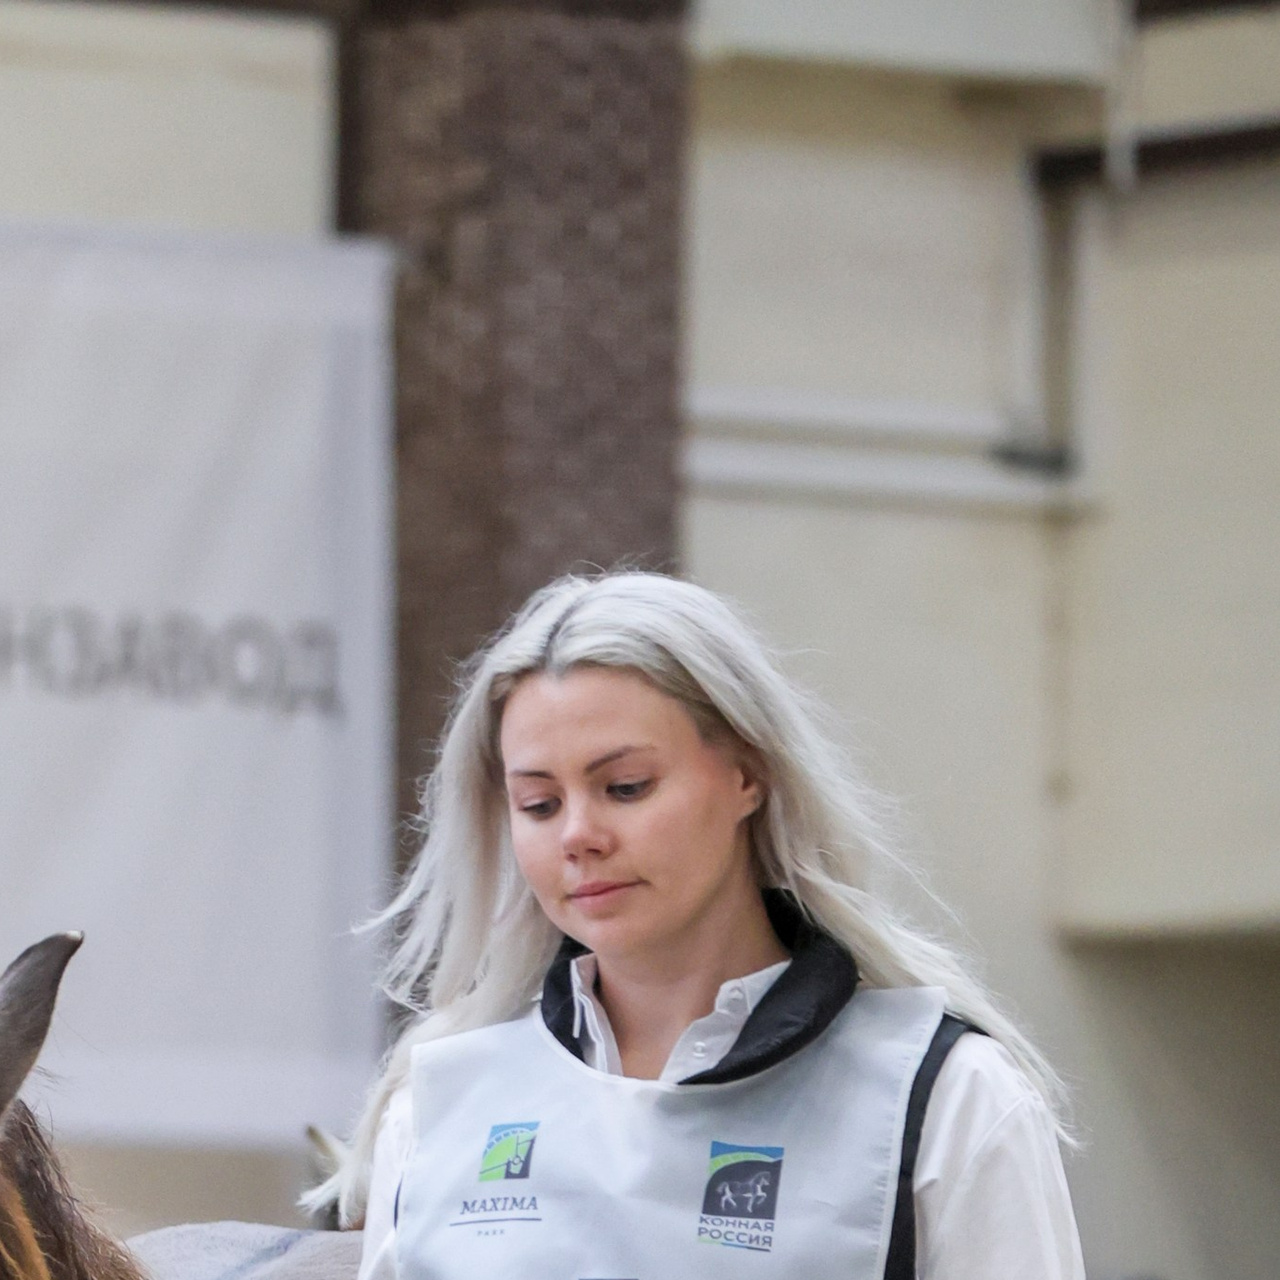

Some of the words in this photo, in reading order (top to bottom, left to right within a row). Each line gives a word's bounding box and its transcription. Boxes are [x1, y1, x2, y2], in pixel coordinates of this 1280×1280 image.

[460, 1196, 538, 1215] MAXIMA
[699, 1215, 775, 1232] КОННАЯ
[697, 1226, 773, 1247] РОССИЯ
